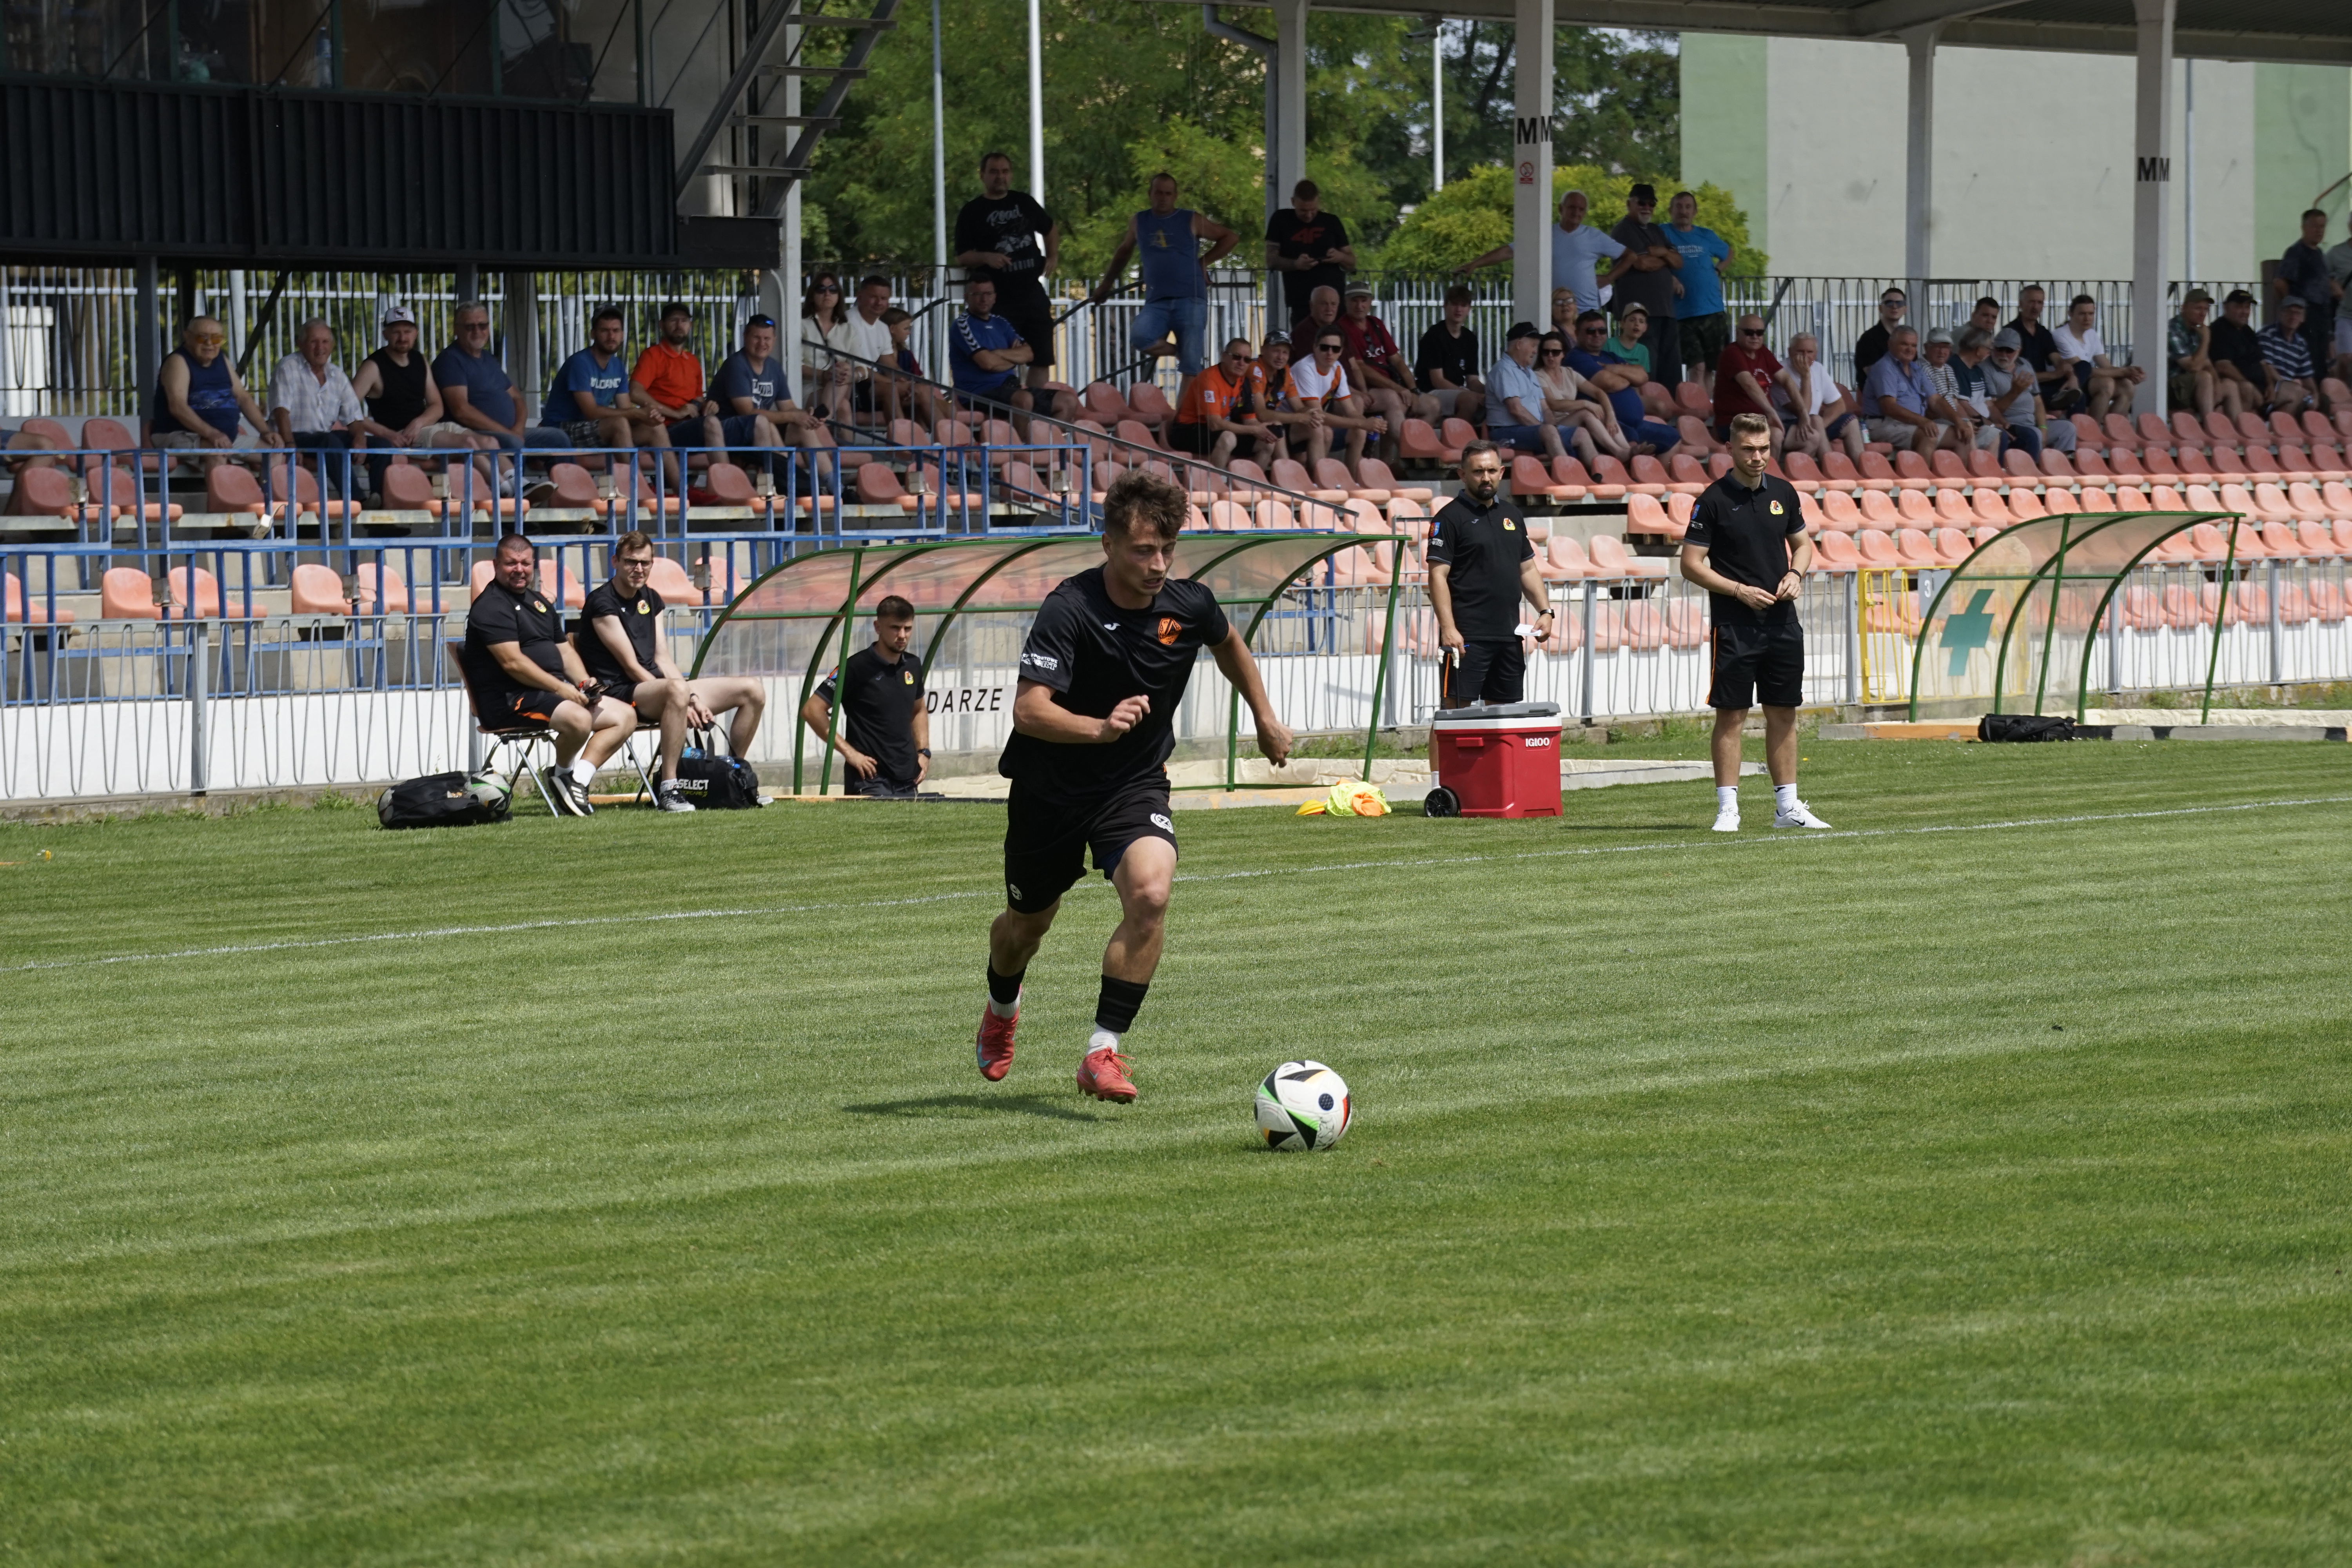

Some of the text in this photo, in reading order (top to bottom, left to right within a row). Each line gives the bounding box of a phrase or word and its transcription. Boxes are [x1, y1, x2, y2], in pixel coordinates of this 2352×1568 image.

[1517, 118, 1537, 145] M
[2137, 157, 2156, 182] M
[1924, 580, 1932, 598] 3
[1030, 653, 1058, 664] SPORTOWE
[927, 688, 1003, 713] DARZE
[1525, 737, 1550, 747] IGLOO
[678, 779, 709, 790] SELECT
